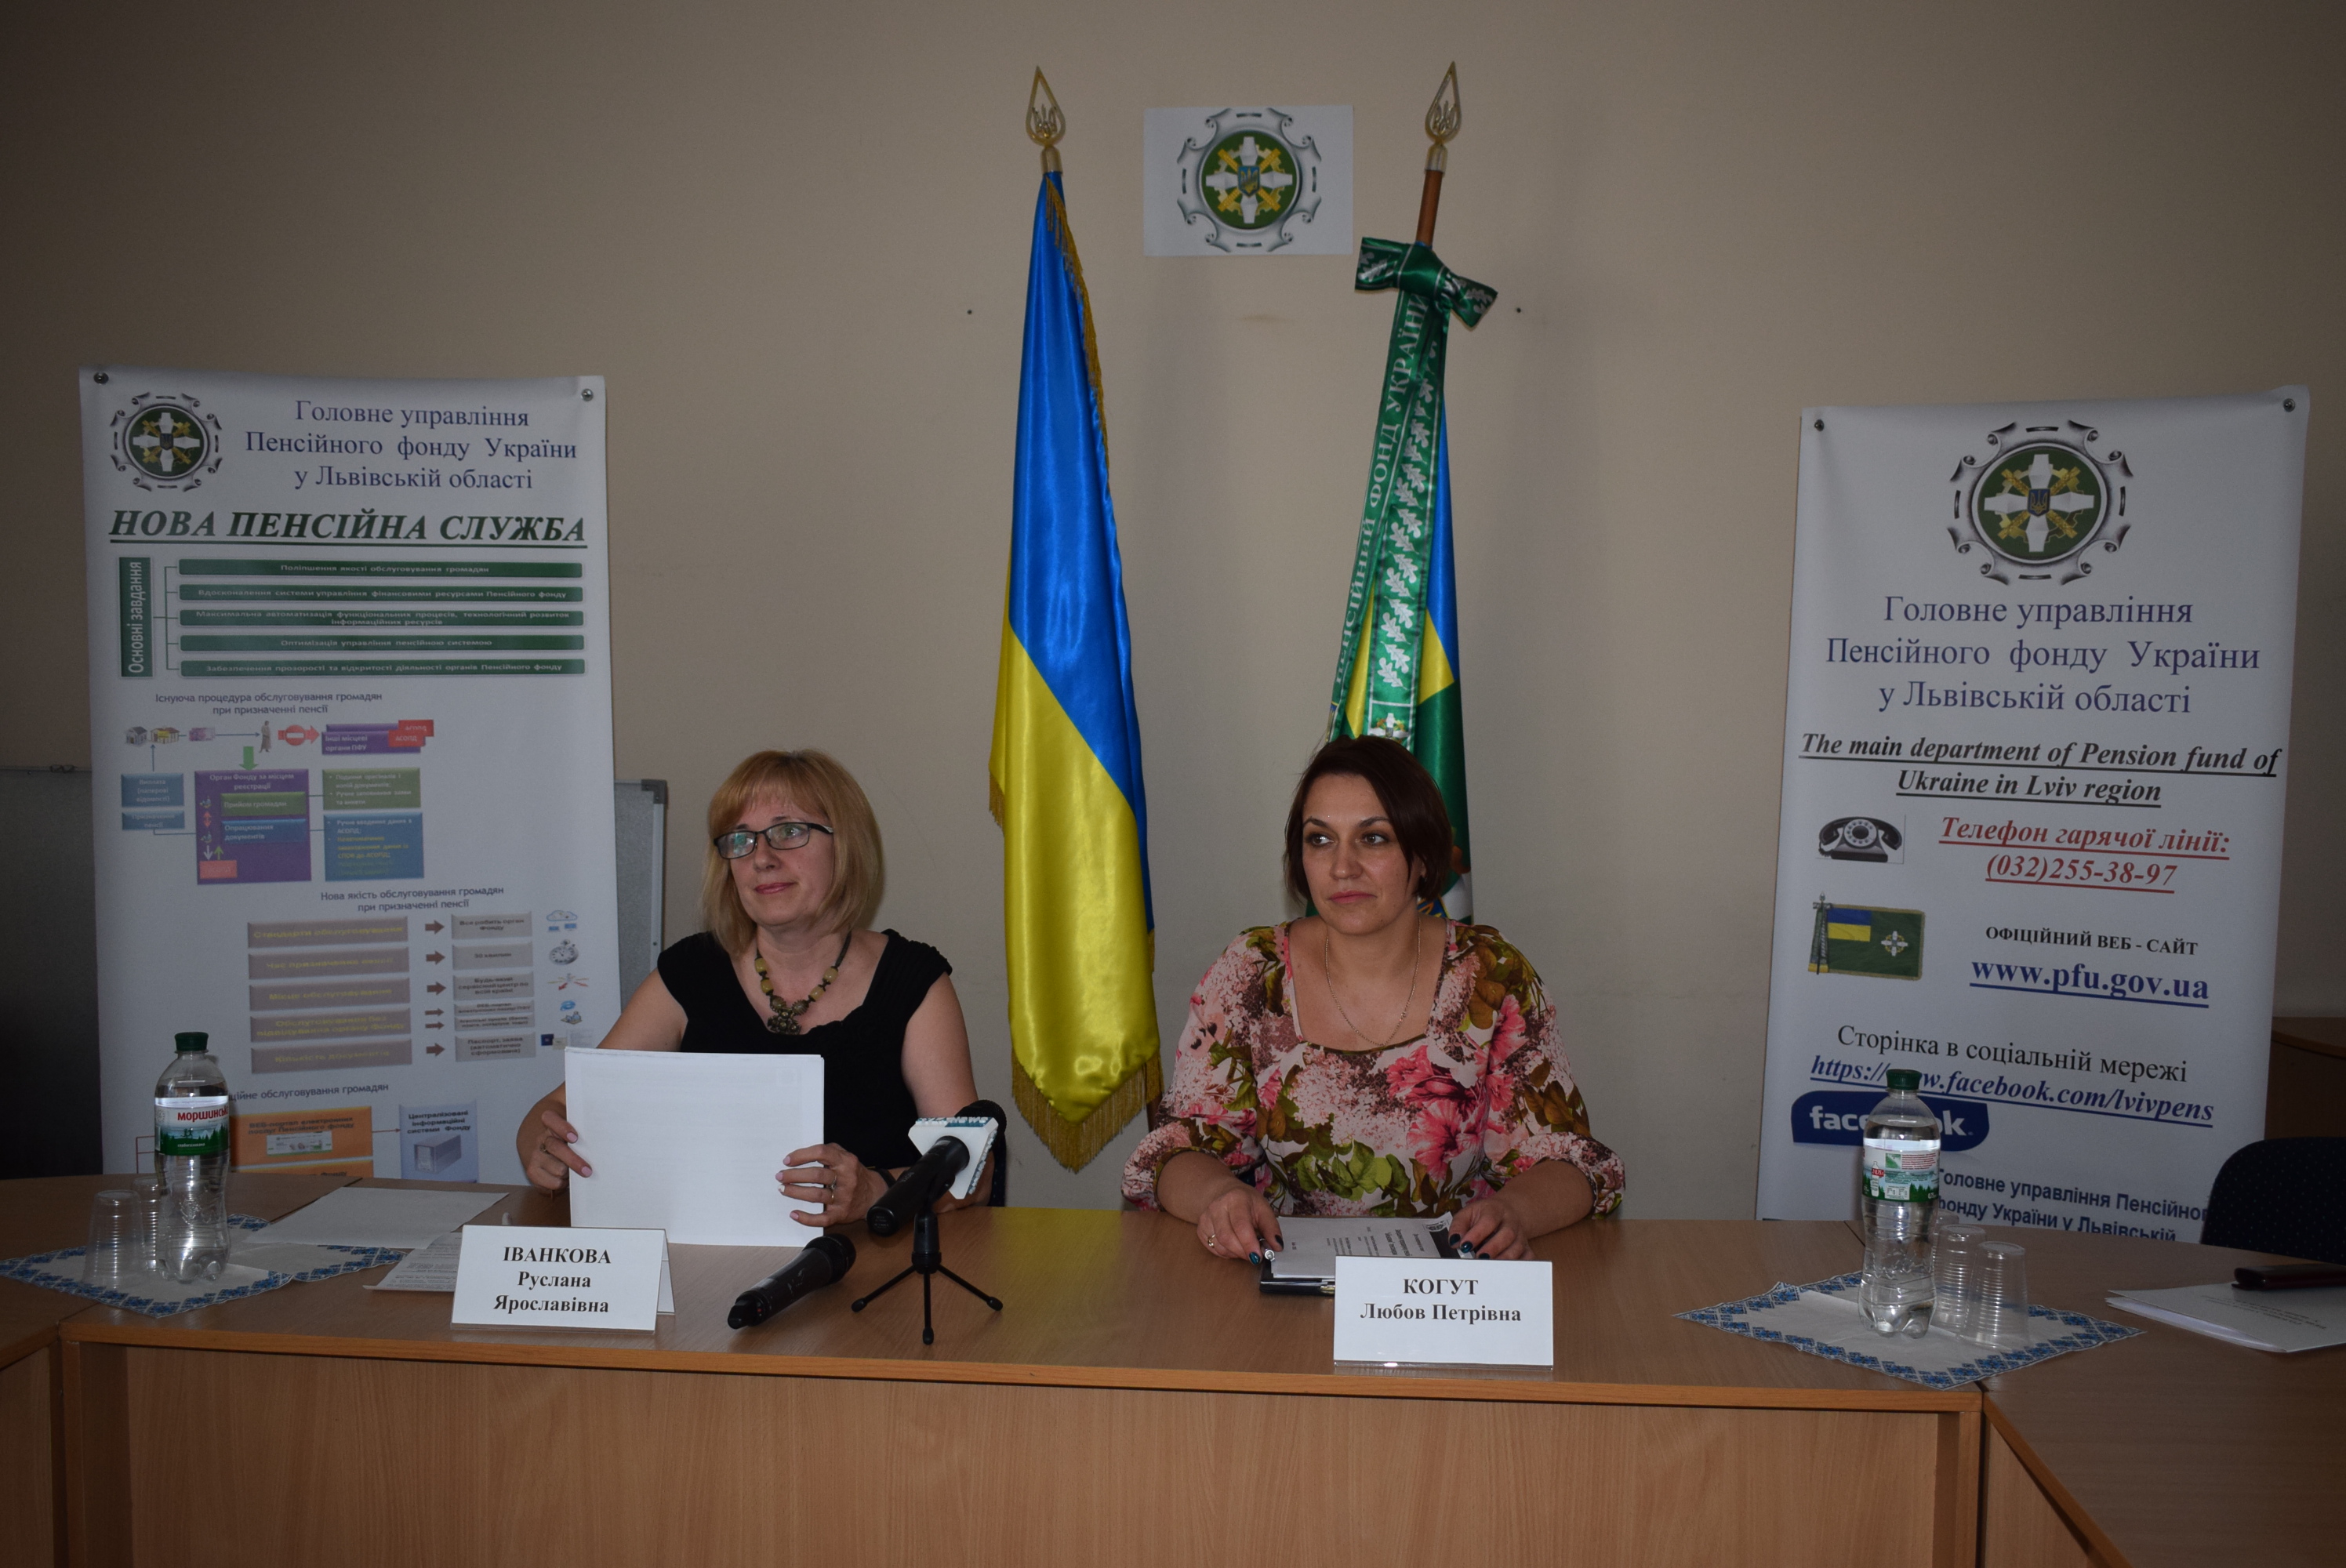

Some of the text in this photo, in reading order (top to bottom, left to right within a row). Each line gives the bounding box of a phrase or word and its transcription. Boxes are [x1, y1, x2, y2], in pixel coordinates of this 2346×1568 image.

[294, 400, 530, 430] Головне управління
[245, 430, 577, 463] Пенсійного фонду України
[1369, 423, 1401, 509] ФОНД
[294, 466, 533, 490] у Львівській області
[108, 508, 586, 542] НОВА ПЕНСІЙНА СЛУЖБА
[126, 562, 147, 673] Основні завдання
[1883, 595, 2193, 630] Головне управління
[1825, 637, 2261, 676] Пенсійного фонду України
[341, 665, 392, 673] відкритості
[534, 664, 562, 673] фонду
[155, 691, 382, 705] Існуюча процедура обслуговування громадян
[1877, 680, 2191, 714] у Львівській області
[212, 704, 329, 717] при призначенні пенсії
[325, 743, 367, 753] органи ПФУ
[342, 734, 368, 742] місцеві
[1801, 732, 2284, 776] The main department of Pension fund of
[209, 773, 232, 782] Орган
[233, 773, 257, 782] Фонду
[269, 772, 295, 781] місцем
[234, 782, 271, 792] реєстрації
[1896, 770, 2162, 805] Ukraine in Lviv region
[224, 800, 288, 809] Прийом громадян
[224, 824, 274, 833] Опрацювання
[224, 833, 265, 842] документів
[1940, 815, 2231, 854] Телефон гарячої лінії:
[1985, 854, 2178, 888] (032)255-38-97
[321, 886, 504, 901] Нова якість обслуговування громадян
[358, 898, 470, 914] при призначенні пенсії
[1985, 924, 2093, 949] ОФІЦІЙНИЙ
[2096, 935, 2133, 951] ВЕБ
[2145, 935, 2199, 956] САЙТ
[1970, 958, 2210, 1003] www.pfu.gov.ua
[1836, 1025, 2188, 1087] Сторінка в соціальній мережі
[261, 1085, 340, 1101] обслуговування
[342, 1082, 390, 1095] громадян
[1810, 1054, 2216, 1122] https://w.facebook.com/lvivpens
[177, 1105, 228, 1123] моршинськ
[408, 1110, 470, 1121] Централізовані
[412, 1117, 466, 1127] інформаційні
[406, 1123, 472, 1135] системи Фонду
[1939, 1168, 2006, 1192] оловне
[2010, 1182, 2111, 1212] управління
[1992, 1202, 2059, 1230] України
[2077, 1215, 2177, 1242] Львівській
[503, 1247, 612, 1265] ІВАНКОВА
[518, 1271, 591, 1290] Руслана
[1403, 1279, 1479, 1296] КОГУТ
[493, 1294, 609, 1315] Ярославівна
[1360, 1303, 1521, 1325] Любов Петрівна
